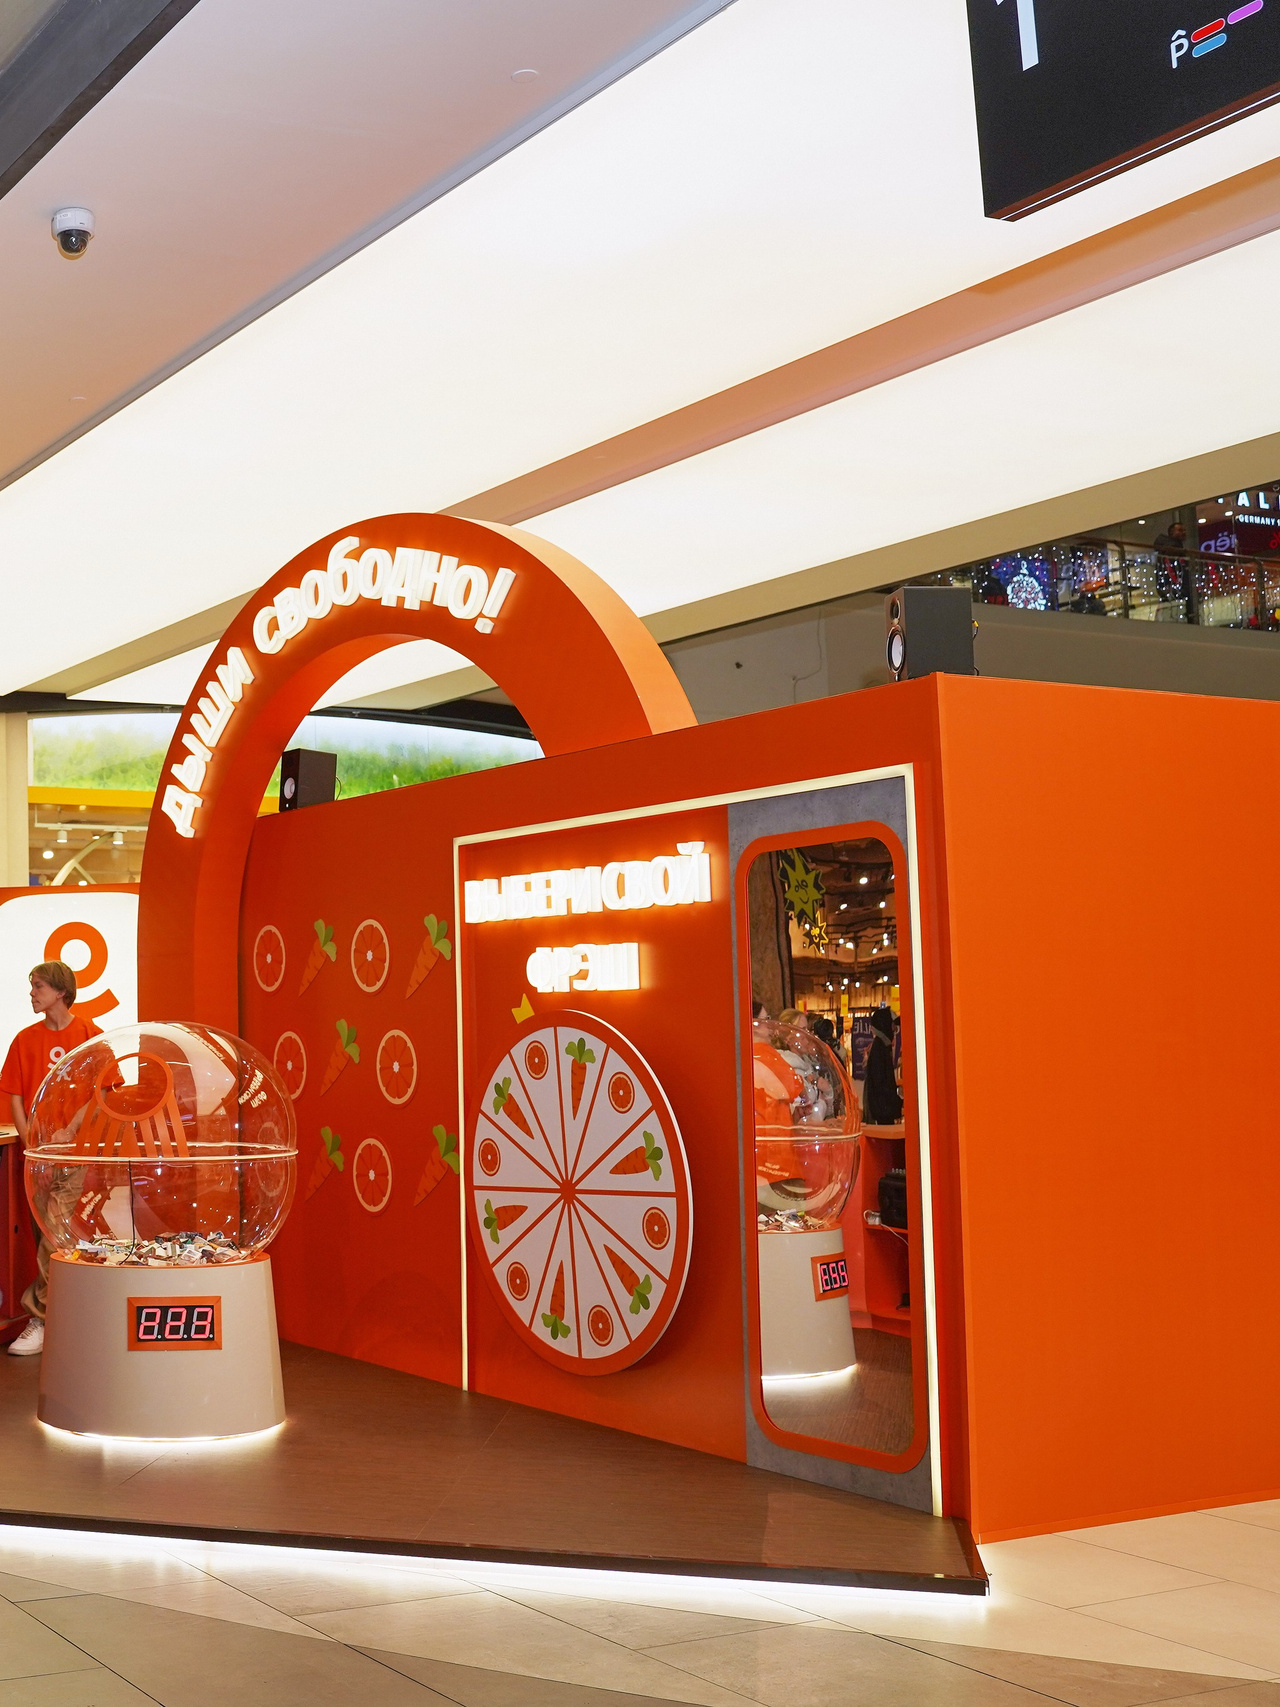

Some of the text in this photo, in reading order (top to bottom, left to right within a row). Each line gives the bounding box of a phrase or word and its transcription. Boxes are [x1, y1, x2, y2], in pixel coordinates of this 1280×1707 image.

[1238, 514, 1276, 526] GERMANY
[464, 841, 712, 924] ВЫБЕРИ СВОЙ
[526, 942, 640, 993] ФРЭШ
